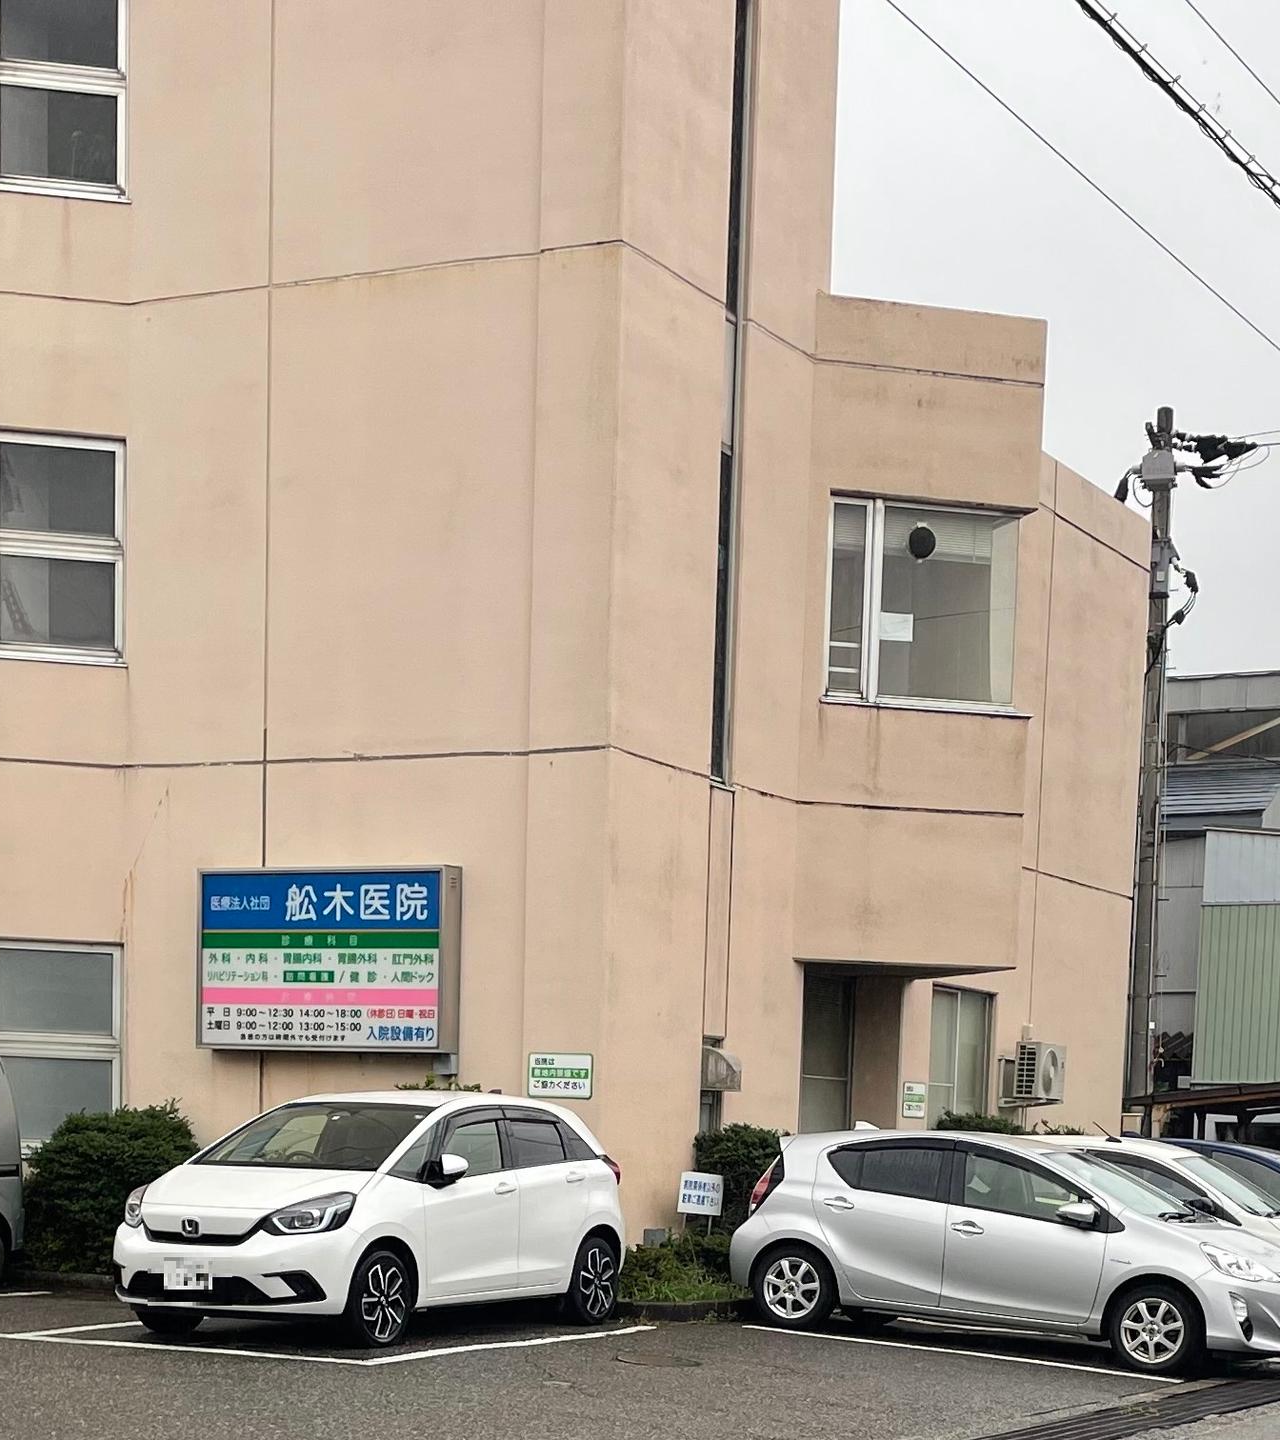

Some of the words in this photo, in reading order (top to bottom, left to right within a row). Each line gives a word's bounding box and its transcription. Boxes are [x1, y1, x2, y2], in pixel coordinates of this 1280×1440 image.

[210, 896, 270, 911] 医療法人社団
[285, 883, 428, 921] 舩木医院
[367, 1026, 435, 1042] 入院設備有り
